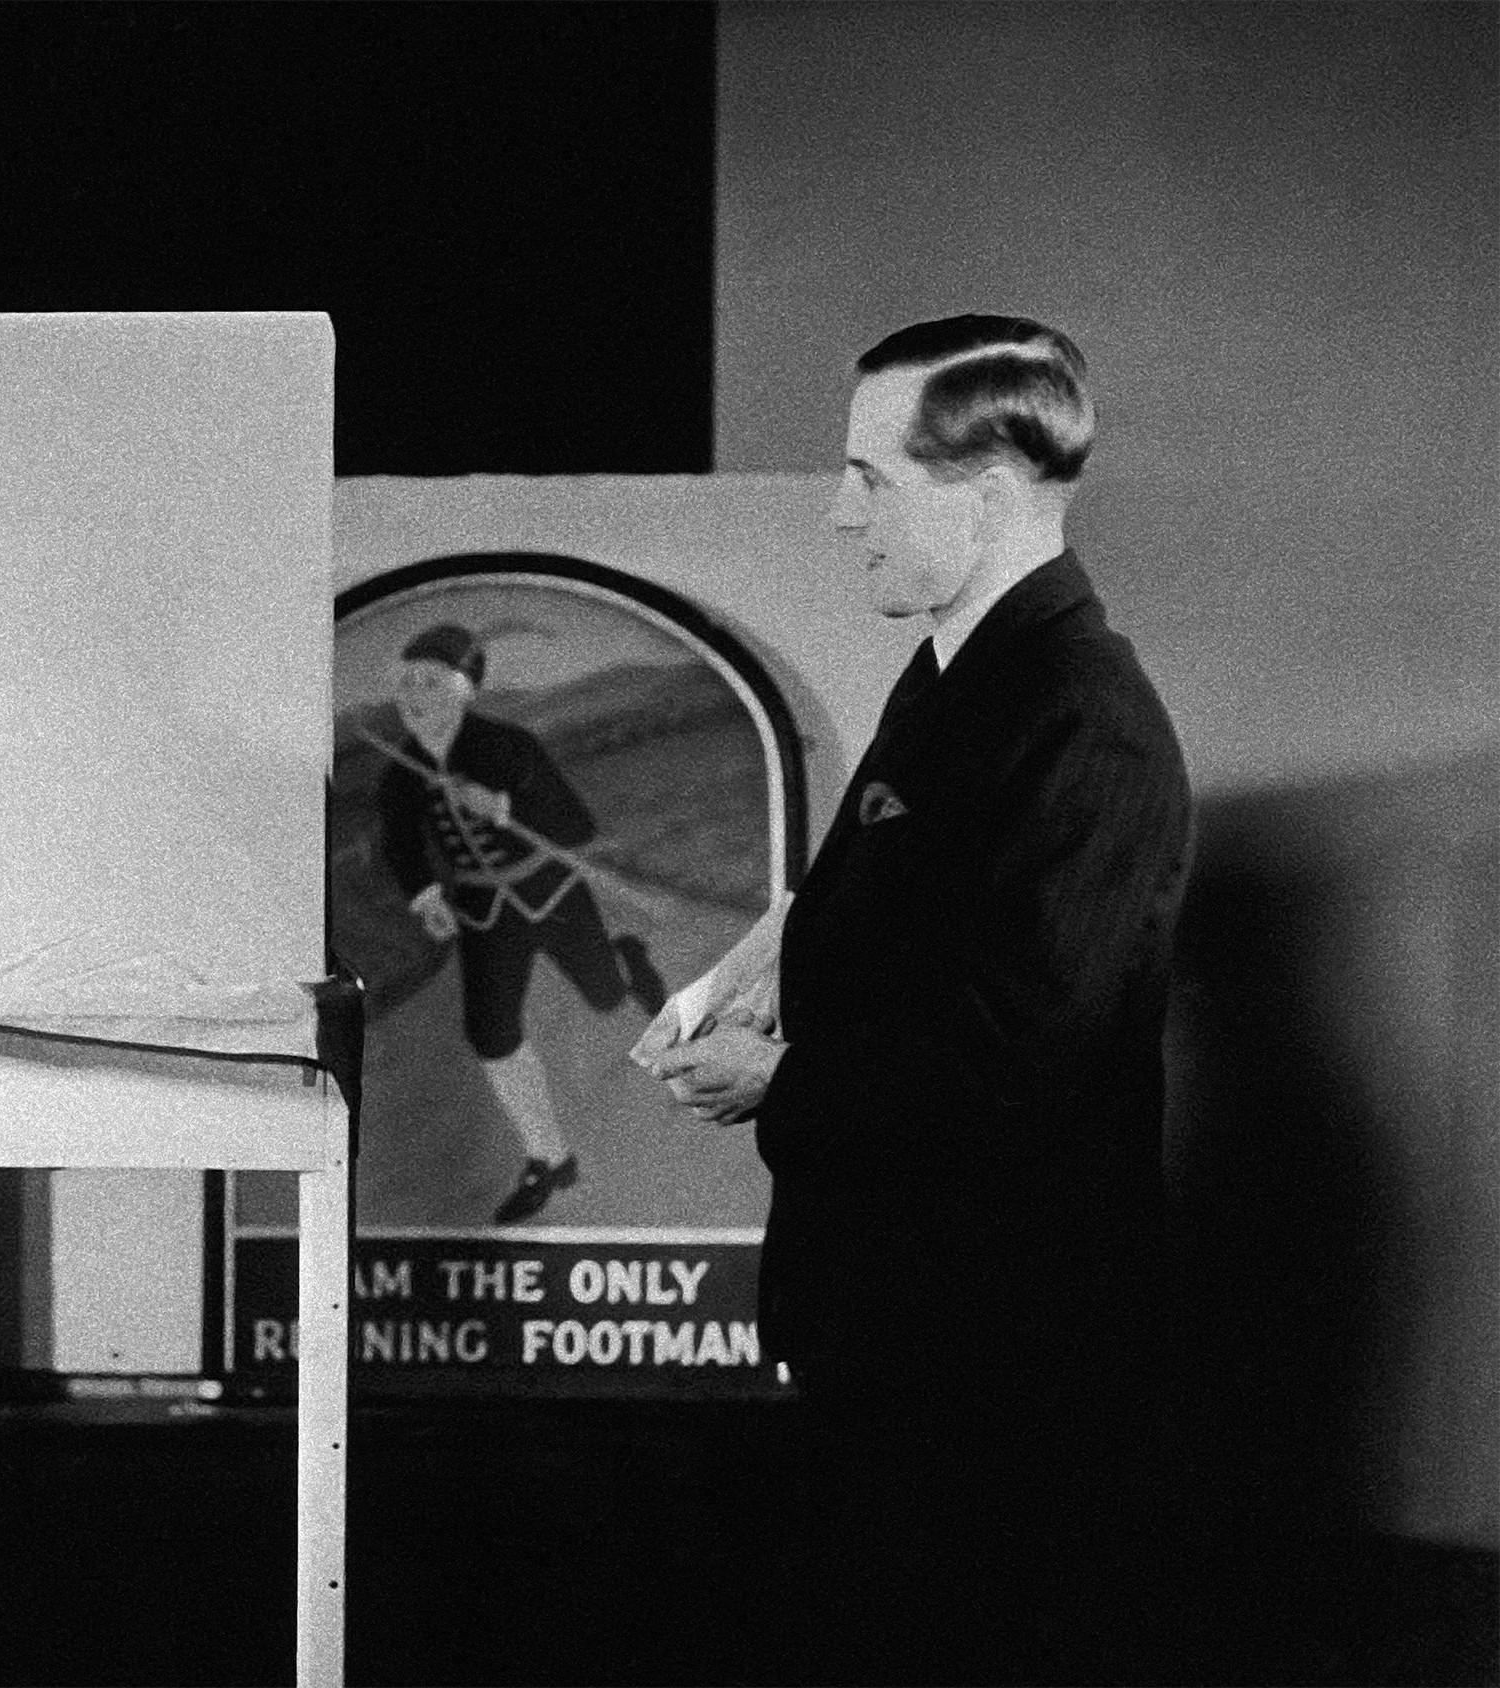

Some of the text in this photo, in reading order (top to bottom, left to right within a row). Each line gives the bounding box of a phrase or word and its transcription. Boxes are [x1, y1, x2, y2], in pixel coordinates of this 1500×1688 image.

[438, 1259, 545, 1303] THE
[569, 1258, 710, 1305] ONLY
[254, 1319, 760, 1367] RNING FOOTMAN
